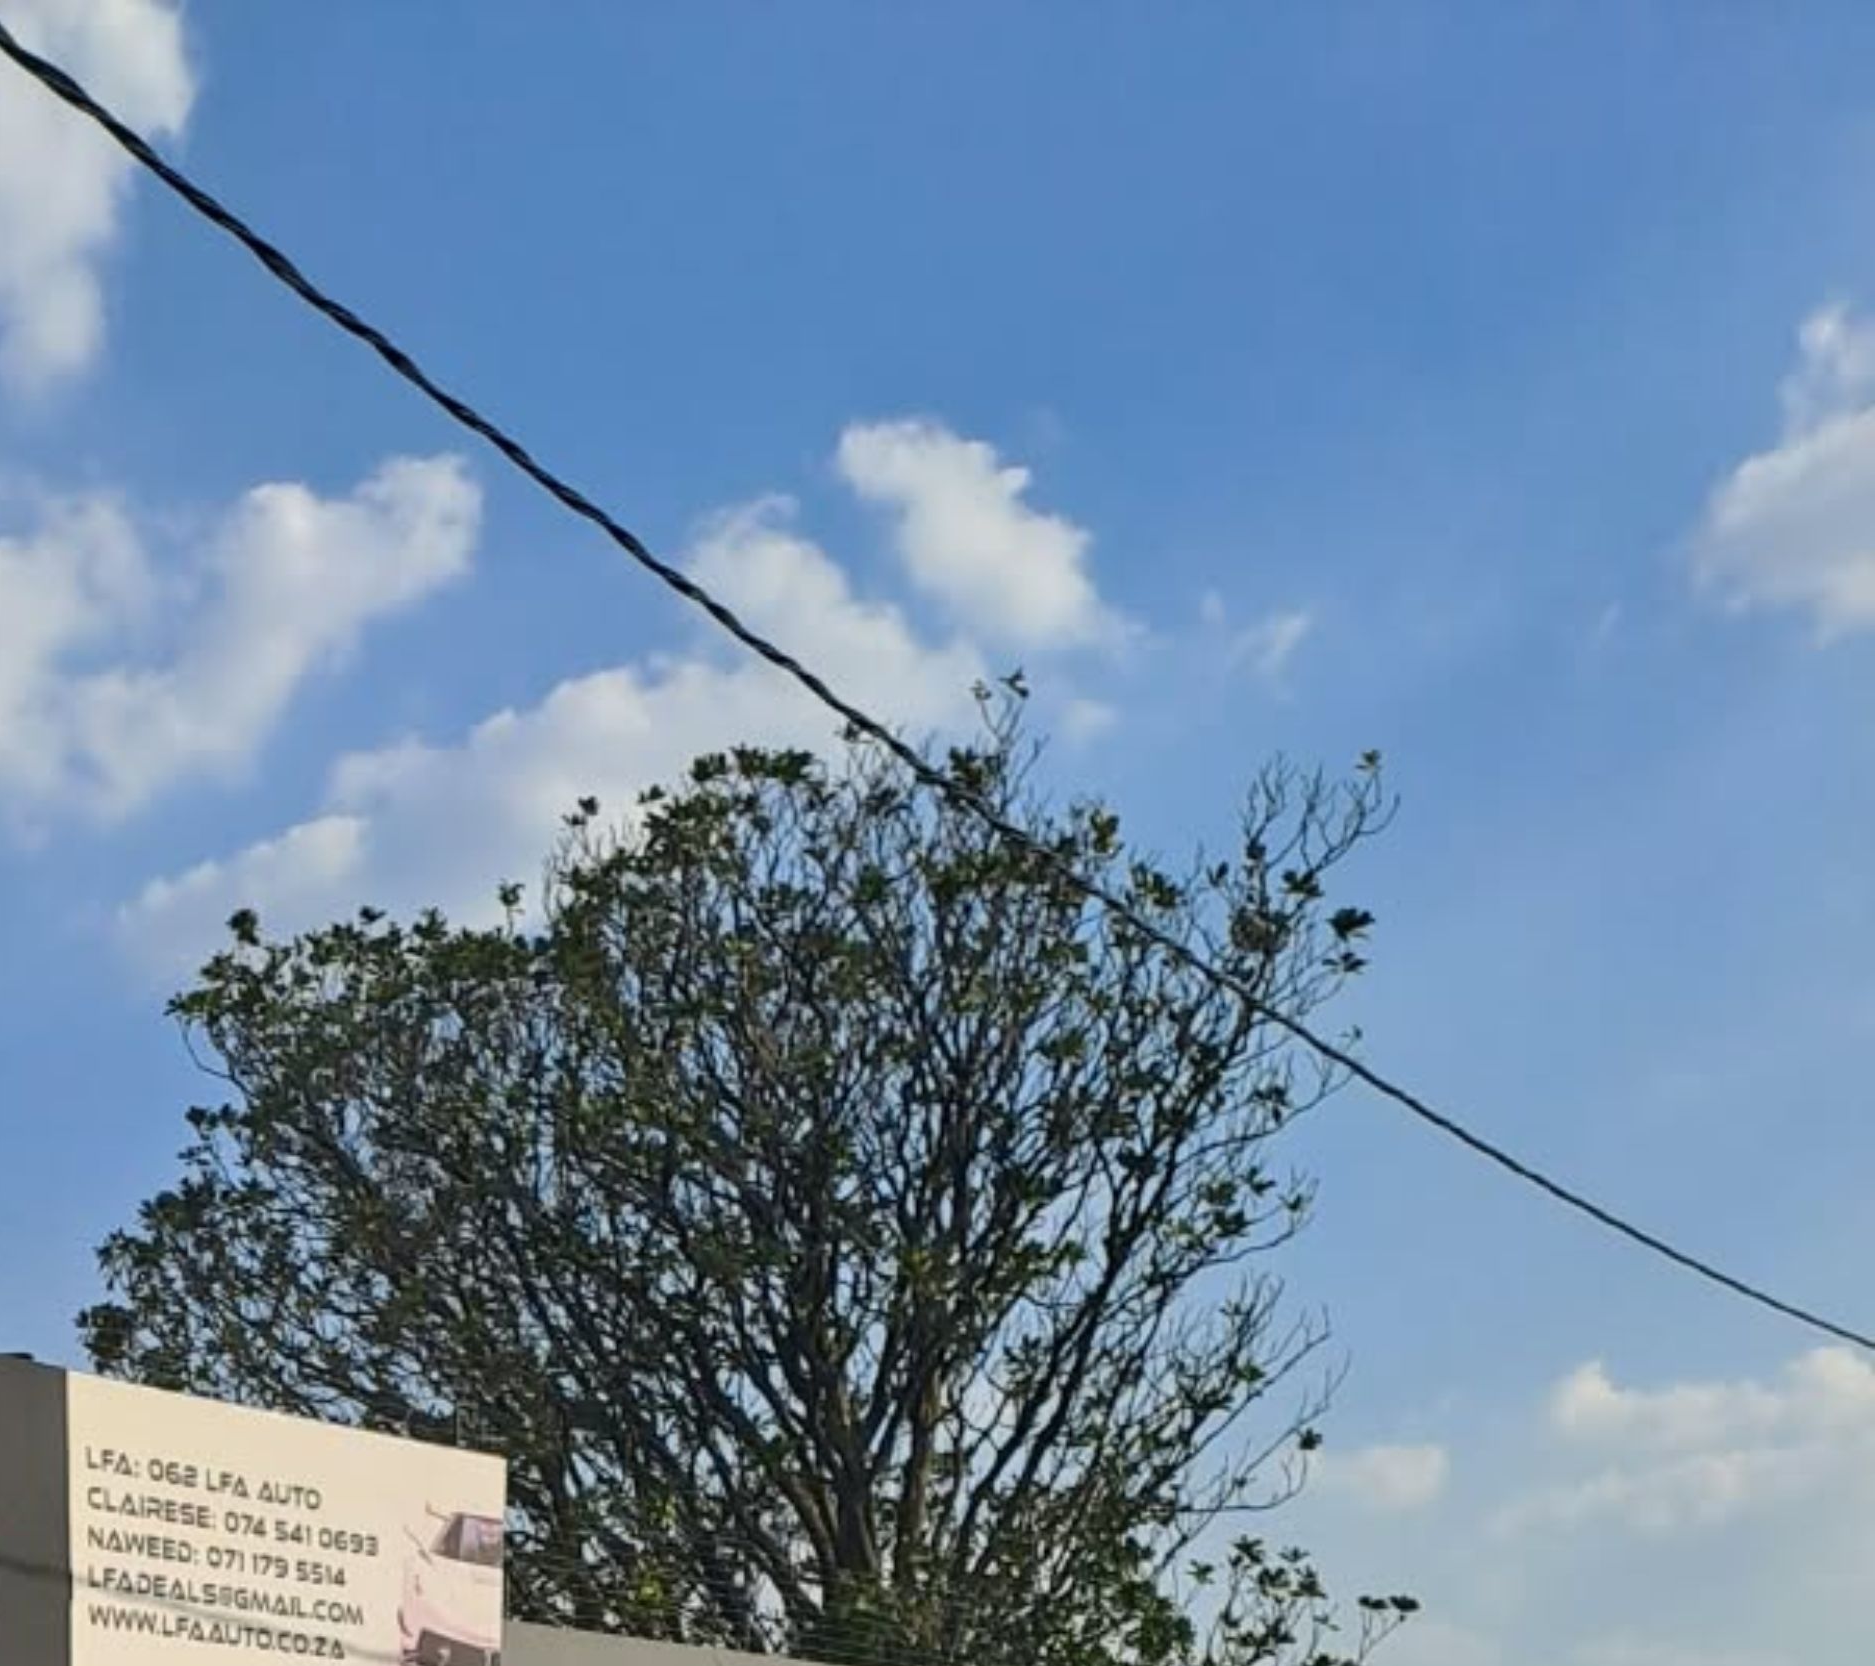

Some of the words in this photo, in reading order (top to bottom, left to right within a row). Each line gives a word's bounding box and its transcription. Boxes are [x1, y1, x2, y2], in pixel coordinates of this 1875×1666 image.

[84, 1446, 140, 1478] LFA:
[147, 1457, 198, 1487] 062
[206, 1468, 250, 1499] LFA
[256, 1480, 321, 1511] AUTO
[87, 1485, 217, 1530] CLAIRESE:
[225, 1511, 267, 1537] 074
[275, 1518, 312, 1547] 541
[318, 1526, 379, 1557] 0693
[87, 1524, 200, 1566] NAWEED:
[207, 1545, 245, 1572] 071
[253, 1553, 289, 1579] 179
[296, 1559, 347, 1587] 5514
[87, 1564, 364, 1626] LFADEALS@GMAIL.COM
[87, 1603, 346, 1660] WWW.LFAAUTO.CO.ZA
